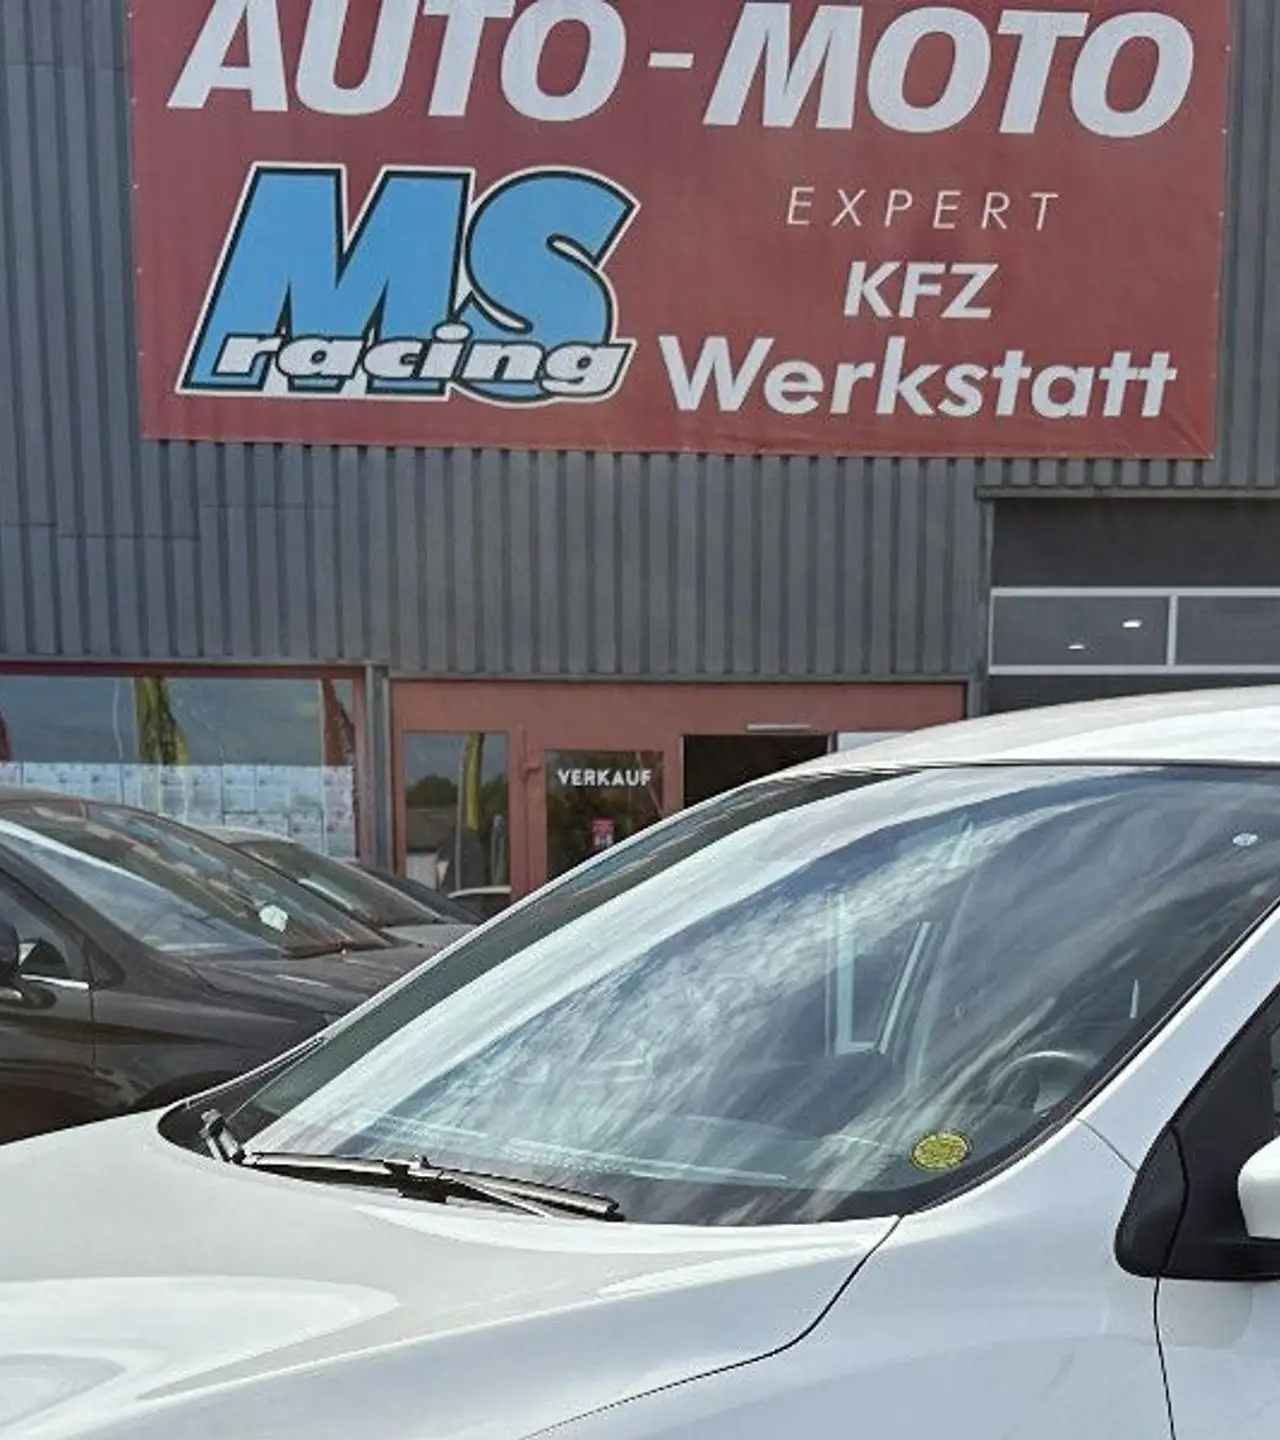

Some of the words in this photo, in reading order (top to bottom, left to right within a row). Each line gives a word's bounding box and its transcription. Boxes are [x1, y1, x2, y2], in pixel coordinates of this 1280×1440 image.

[786, 186, 1059, 231] EXPERT
[176, 162, 641, 408] MS
[842, 260, 999, 319] KFZ
[216, 320, 634, 399] racing
[658, 335, 1178, 419] Werkstatt
[557, 767, 652, 787] VERKAUF
